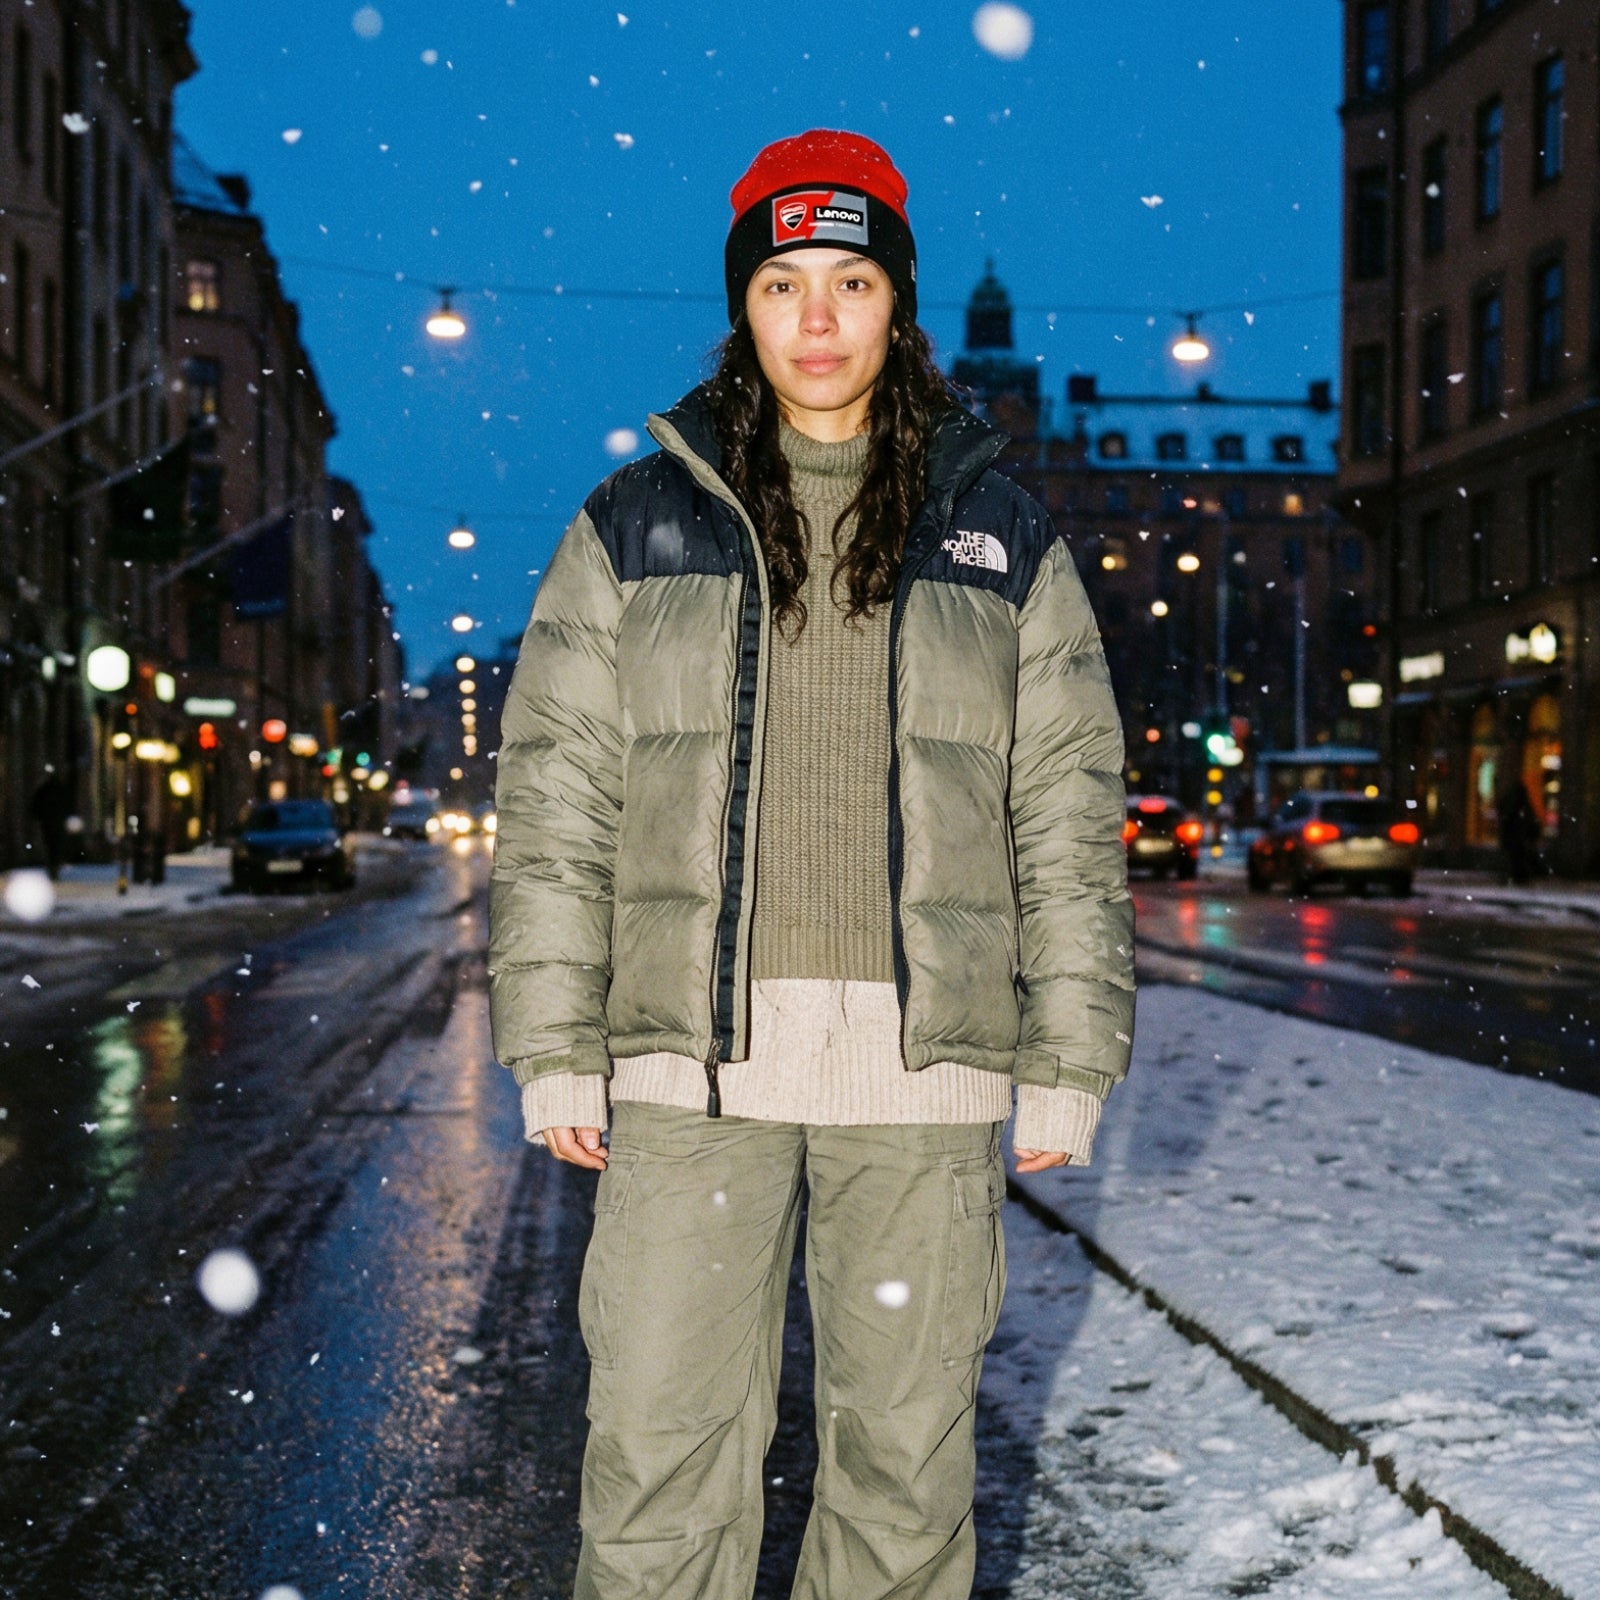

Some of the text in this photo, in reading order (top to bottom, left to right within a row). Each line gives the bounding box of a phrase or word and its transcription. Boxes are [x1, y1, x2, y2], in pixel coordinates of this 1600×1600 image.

[816, 208, 861, 222] Lenovo
[956, 530, 985, 543] THE
[953, 551, 985, 567] FACE
